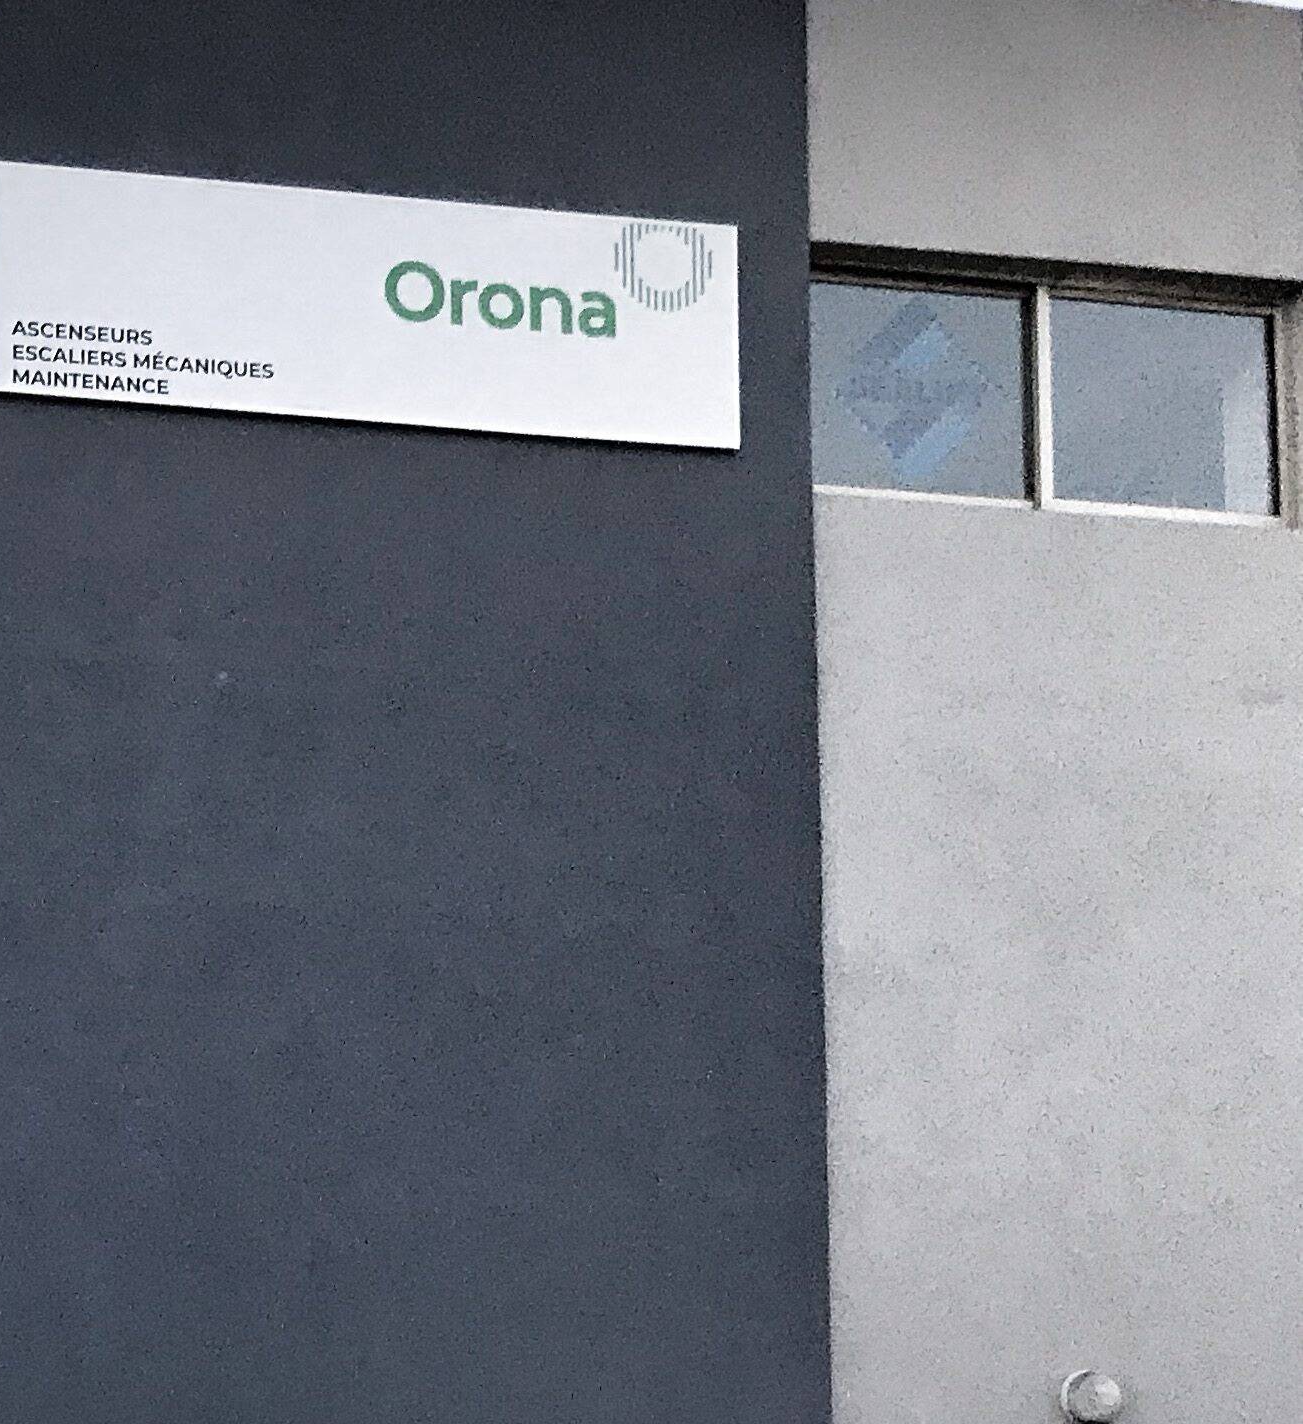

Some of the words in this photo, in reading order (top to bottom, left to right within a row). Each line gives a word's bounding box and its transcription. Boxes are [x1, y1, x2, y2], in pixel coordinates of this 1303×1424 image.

[385, 261, 616, 336] Orona
[11, 320, 153, 345] ASCENSEURS
[11, 344, 127, 368] ESCALIERS
[133, 351, 275, 379] MÉCANIQUES
[11, 369, 170, 395] MAINTENANCE
